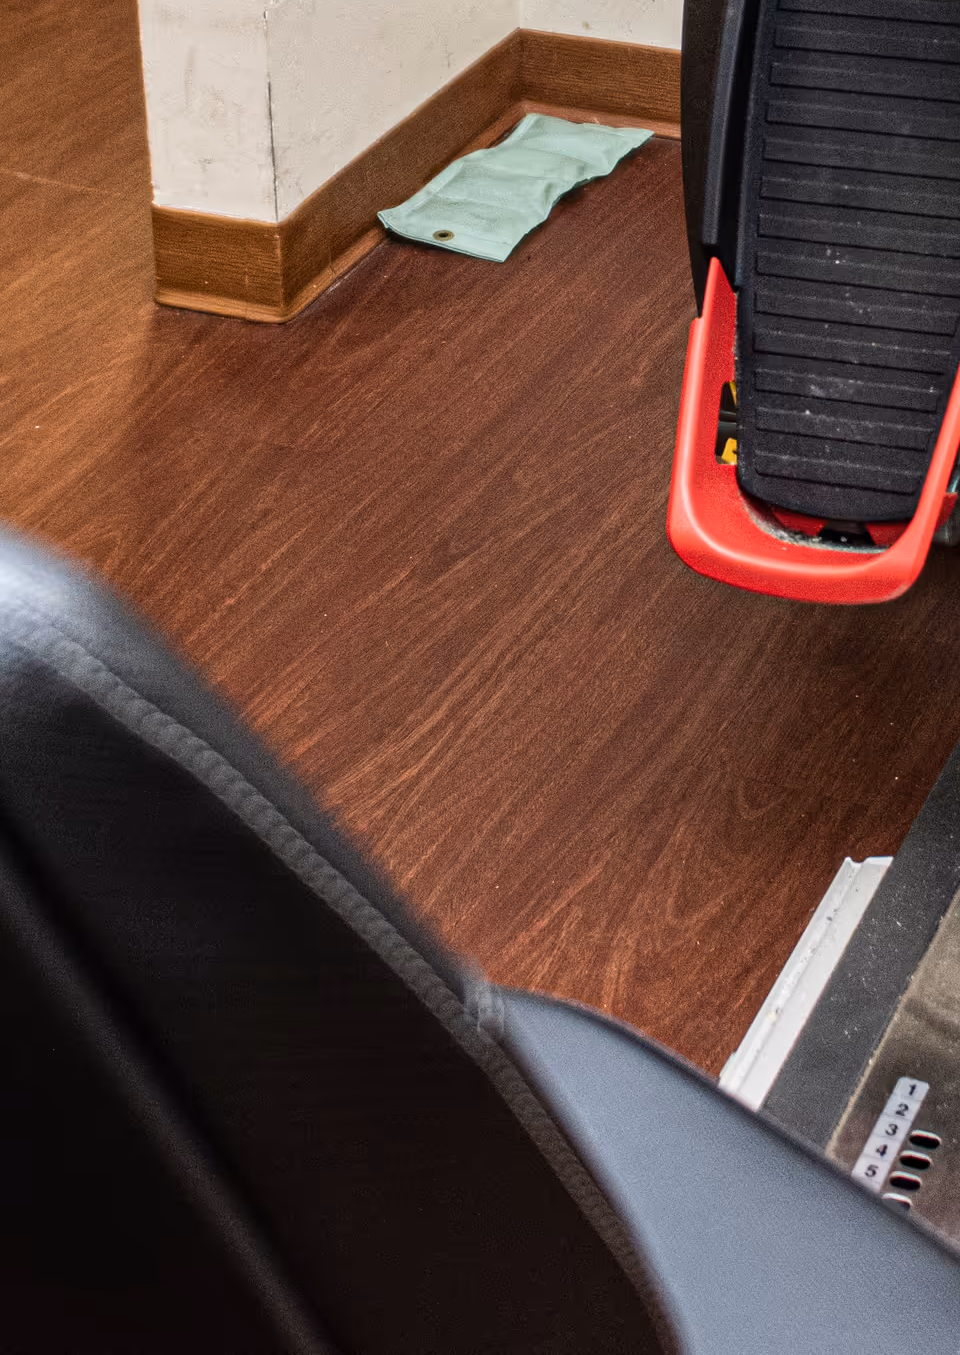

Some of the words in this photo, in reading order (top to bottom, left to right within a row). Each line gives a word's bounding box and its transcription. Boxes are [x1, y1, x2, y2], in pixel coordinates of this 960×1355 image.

[908, 1084, 917, 1096] 1
[895, 1103, 909, 1116] 2
[885, 1124, 898, 1136] 3
[876, 1144, 888, 1157] 4
[865, 1165, 879, 1177] 5
